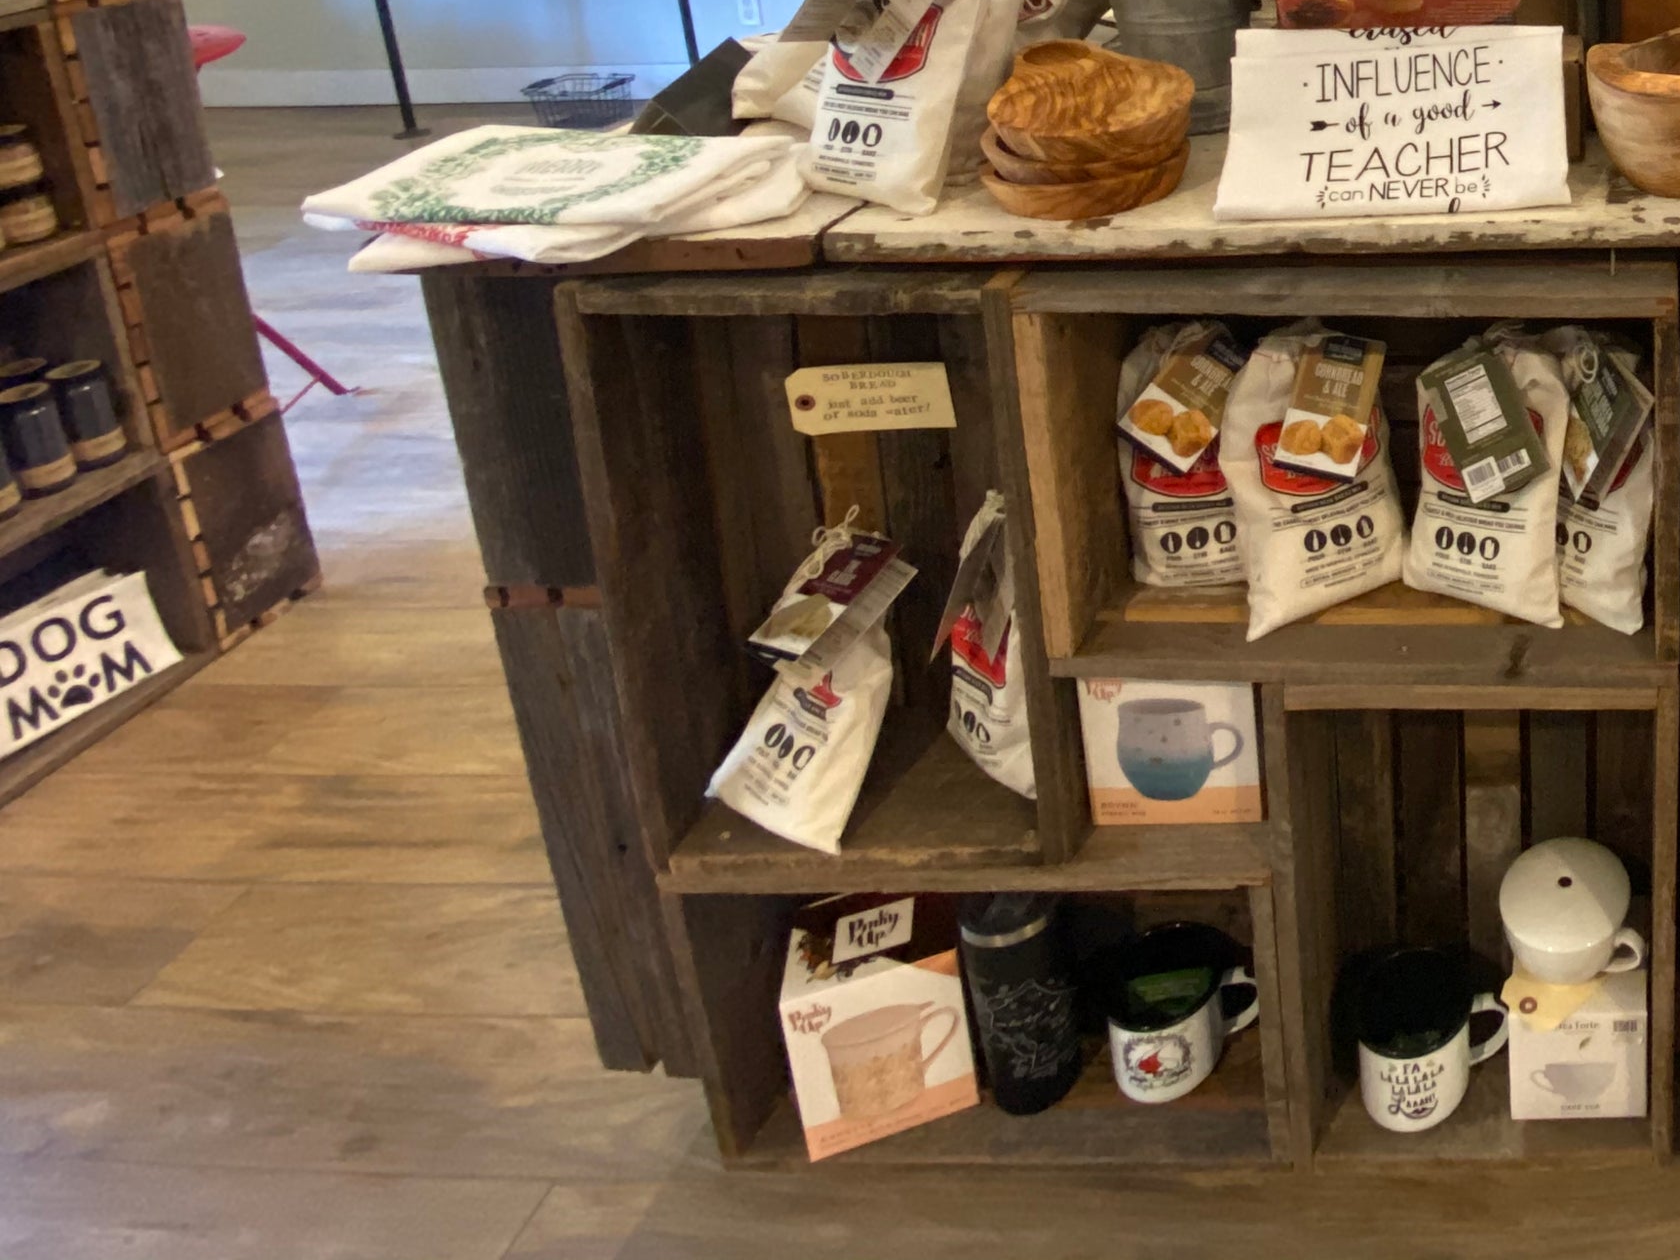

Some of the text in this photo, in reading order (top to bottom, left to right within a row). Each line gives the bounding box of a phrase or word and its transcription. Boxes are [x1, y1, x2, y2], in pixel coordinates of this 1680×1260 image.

[1315, 45, 1492, 104] INFLUENCE
[1345, 89, 1477, 141] of a good
[1300, 131, 1510, 182] TEACHER
[1328, 176, 1478, 202] can NEVER be
[822, 369, 912, 383] SOBERDOUGH
[1315, 362, 1365, 386] CORNBREAD
[849, 380, 897, 390] BREAD
[1322, 380, 1351, 398] & ALE
[823, 410, 840, 421] or
[848, 909, 899, 946] Pinky
[856, 930, 887, 947] Up
[788, 1003, 832, 1032] Pinky
[799, 1020, 823, 1034] Up
[1403, 1063, 1421, 1075] FA
